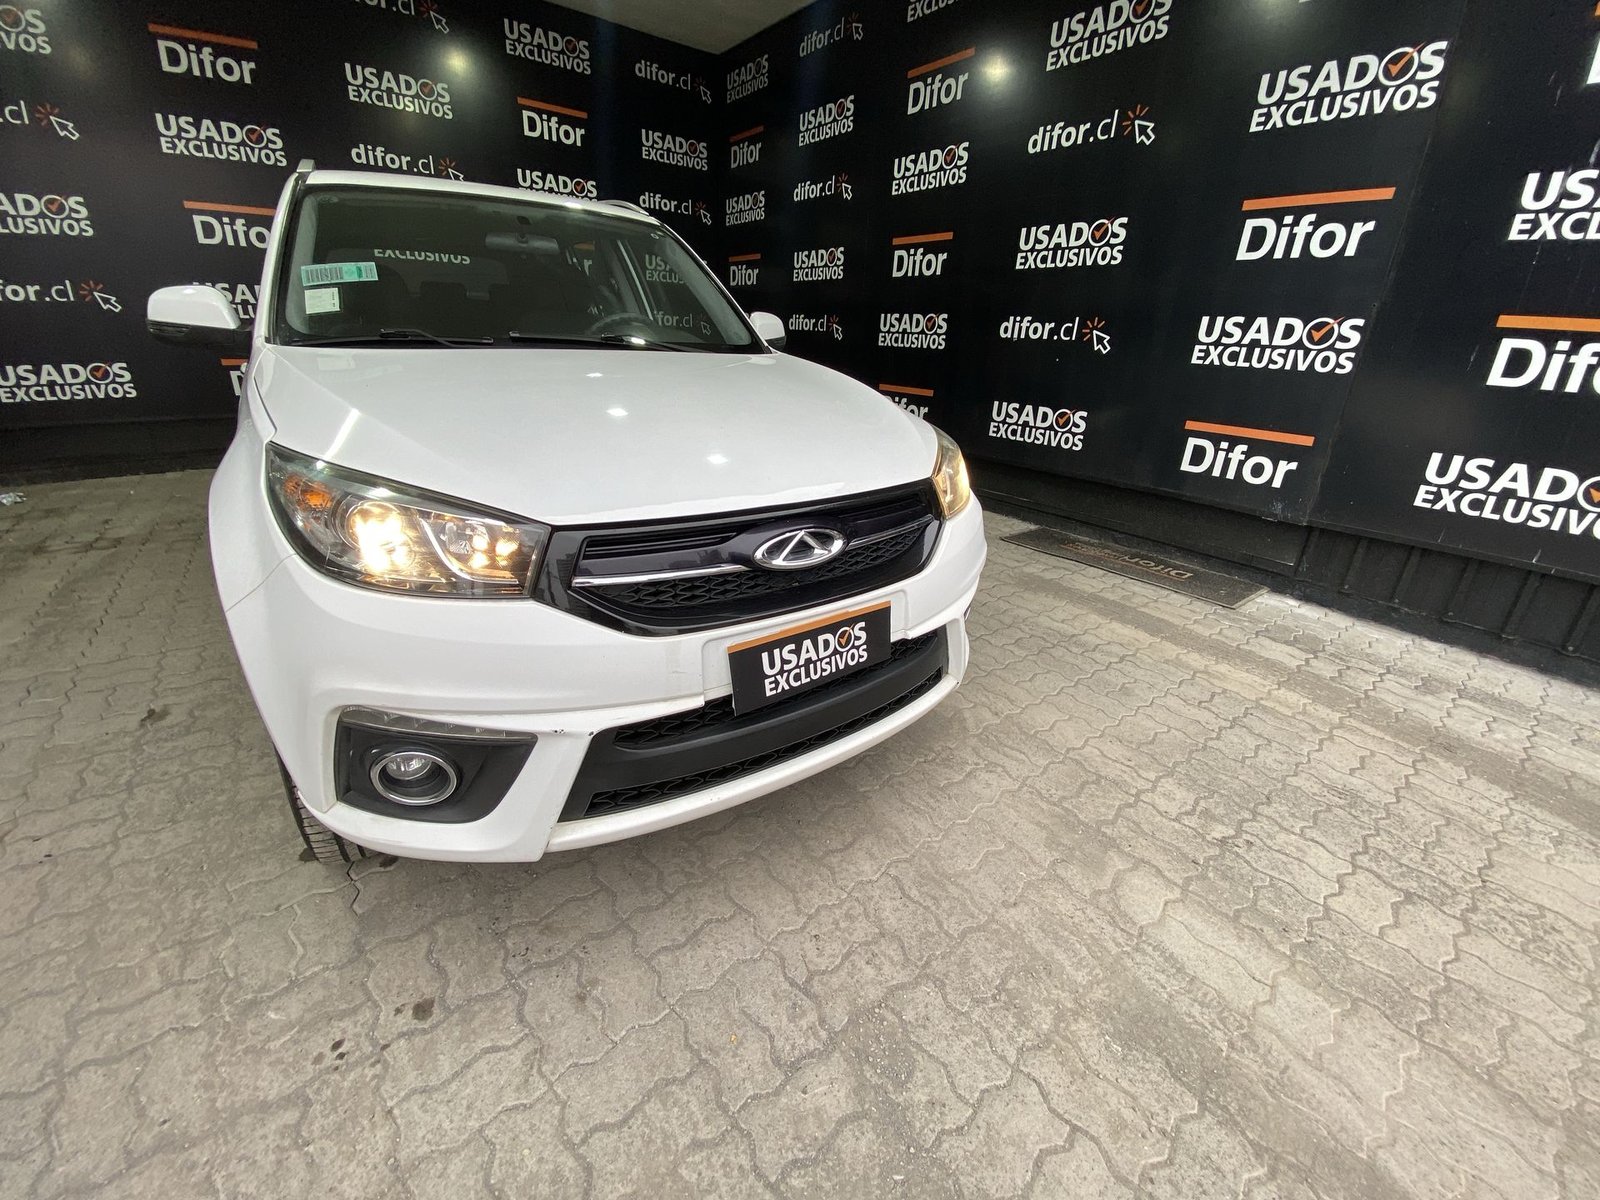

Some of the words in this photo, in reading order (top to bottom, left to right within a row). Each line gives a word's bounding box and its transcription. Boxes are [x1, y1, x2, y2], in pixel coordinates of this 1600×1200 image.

[503, 17, 590, 60] USADOS
[799, 17, 845, 58] difor.cl
[1045, 15, 1170, 72] EXCLUSIVOS
[157, 39, 256, 84] Difor
[505, 39, 591, 75] EXCLUSIVOS
[727, 54, 769, 89] USADOS
[1256, 40, 1449, 105] USADOS
[345, 62, 450, 103] USADOS
[635, 60, 691, 91] difor.cl
[726, 73, 769, 104] EXCLUSIVOS
[348, 85, 453, 120] EXCLUSIVOS
[907, 72, 969, 115] Difor
[1249, 80, 1440, 133] EXCLUSIVOS
[522, 109, 585, 147] Difor
[800, 95, 855, 132] USADOS
[155, 113, 283, 149] USADOS
[641, 128, 708, 158] USADOS
[799, 117, 854, 147] EXCLUSIVOS
[1027, 109, 1119, 154] difor.cl
[160, 137, 287, 167] EXCLUSIVOS
[351, 143, 435, 175] difor.cl
[642, 146, 708, 171] EXCLUSIVOS
[731, 141, 762, 169] Difor
[893, 141, 969, 179] USADOS
[517, 168, 598, 198] USADOS
[793, 175, 836, 202] difor.cl
[892, 166, 967, 196] EXCLUSIVOS
[639, 192, 692, 215] difor.cl
[726, 190, 765, 214] USADOS
[726, 207, 765, 226] EXCLUSIVOS
[1019, 216, 1129, 251] USADOS
[1235, 213, 1376, 261] Difor
[793, 247, 845, 269] USADOS
[892, 247, 948, 278] Difor
[1015, 245, 1124, 270] EXCLUSIVOS
[729, 265, 759, 287] Difor
[793, 265, 844, 282] EXCLUSIVOS
[788, 314, 827, 332] difor.cl
[879, 313, 948, 335] USADOS
[1000, 316, 1080, 341] difor.cl
[1197, 315, 1366, 350] USADOS
[878, 332, 946, 350] EXCLUSIVOS
[0, 362, 132, 386] USADOS
[1190, 345, 1356, 375] EXCLUSIVOS
[1485, 337, 1600, 394] Dif
[0, 383, 137, 403] EXCLUSIVOS
[991, 400, 1088, 433] USADOS
[988, 421, 1084, 451] EXCLUSIVOS
[1180, 436, 1299, 489] Difor
[1412, 485, 1600, 541] EXCLUSIV
[1118, 555, 1194, 580] Difor
[761, 621, 867, 676] USADOS
[764, 645, 868, 697] EXCLUSIVOS
